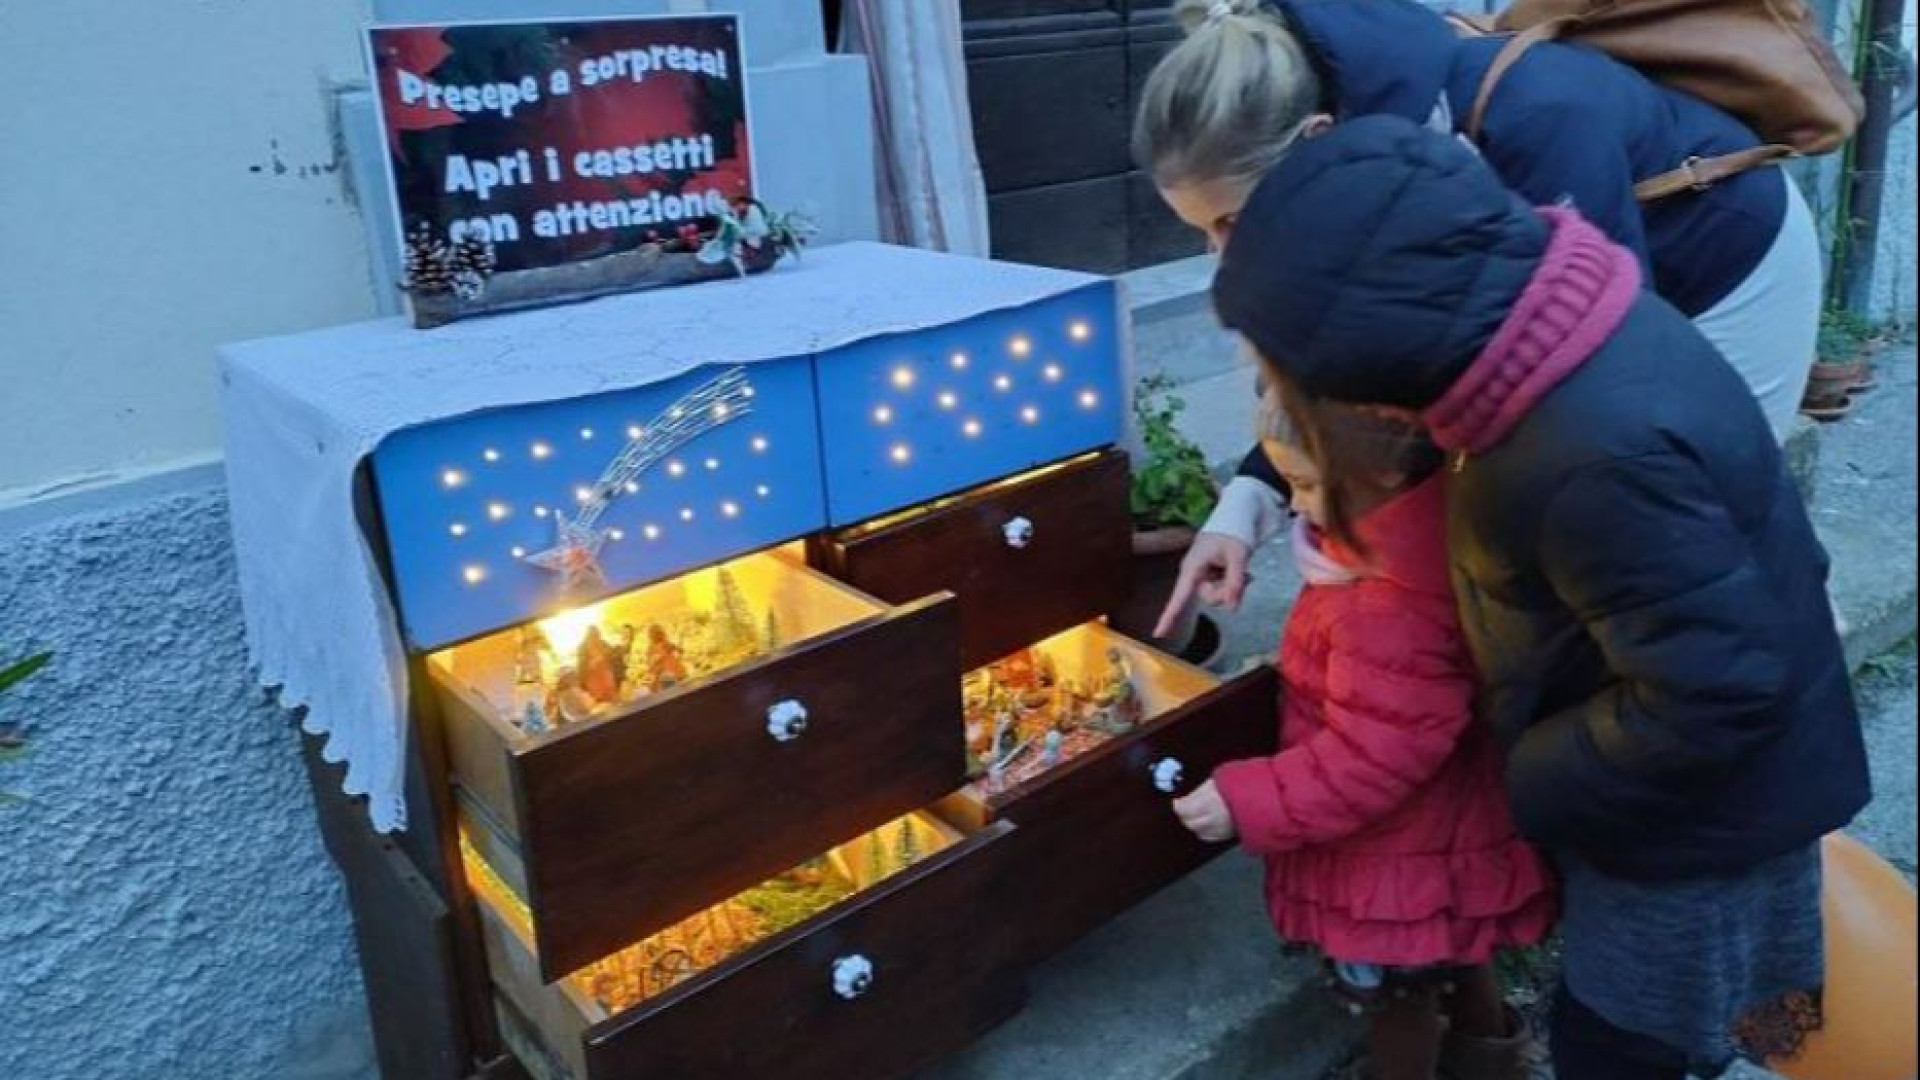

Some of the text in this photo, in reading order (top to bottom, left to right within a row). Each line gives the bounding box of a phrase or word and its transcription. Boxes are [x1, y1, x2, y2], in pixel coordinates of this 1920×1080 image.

[397, 45, 727, 117] Presepe a sorpresa!
[444, 134, 715, 199] Apri i cassetti
[533, 188, 723, 238] attenzione
